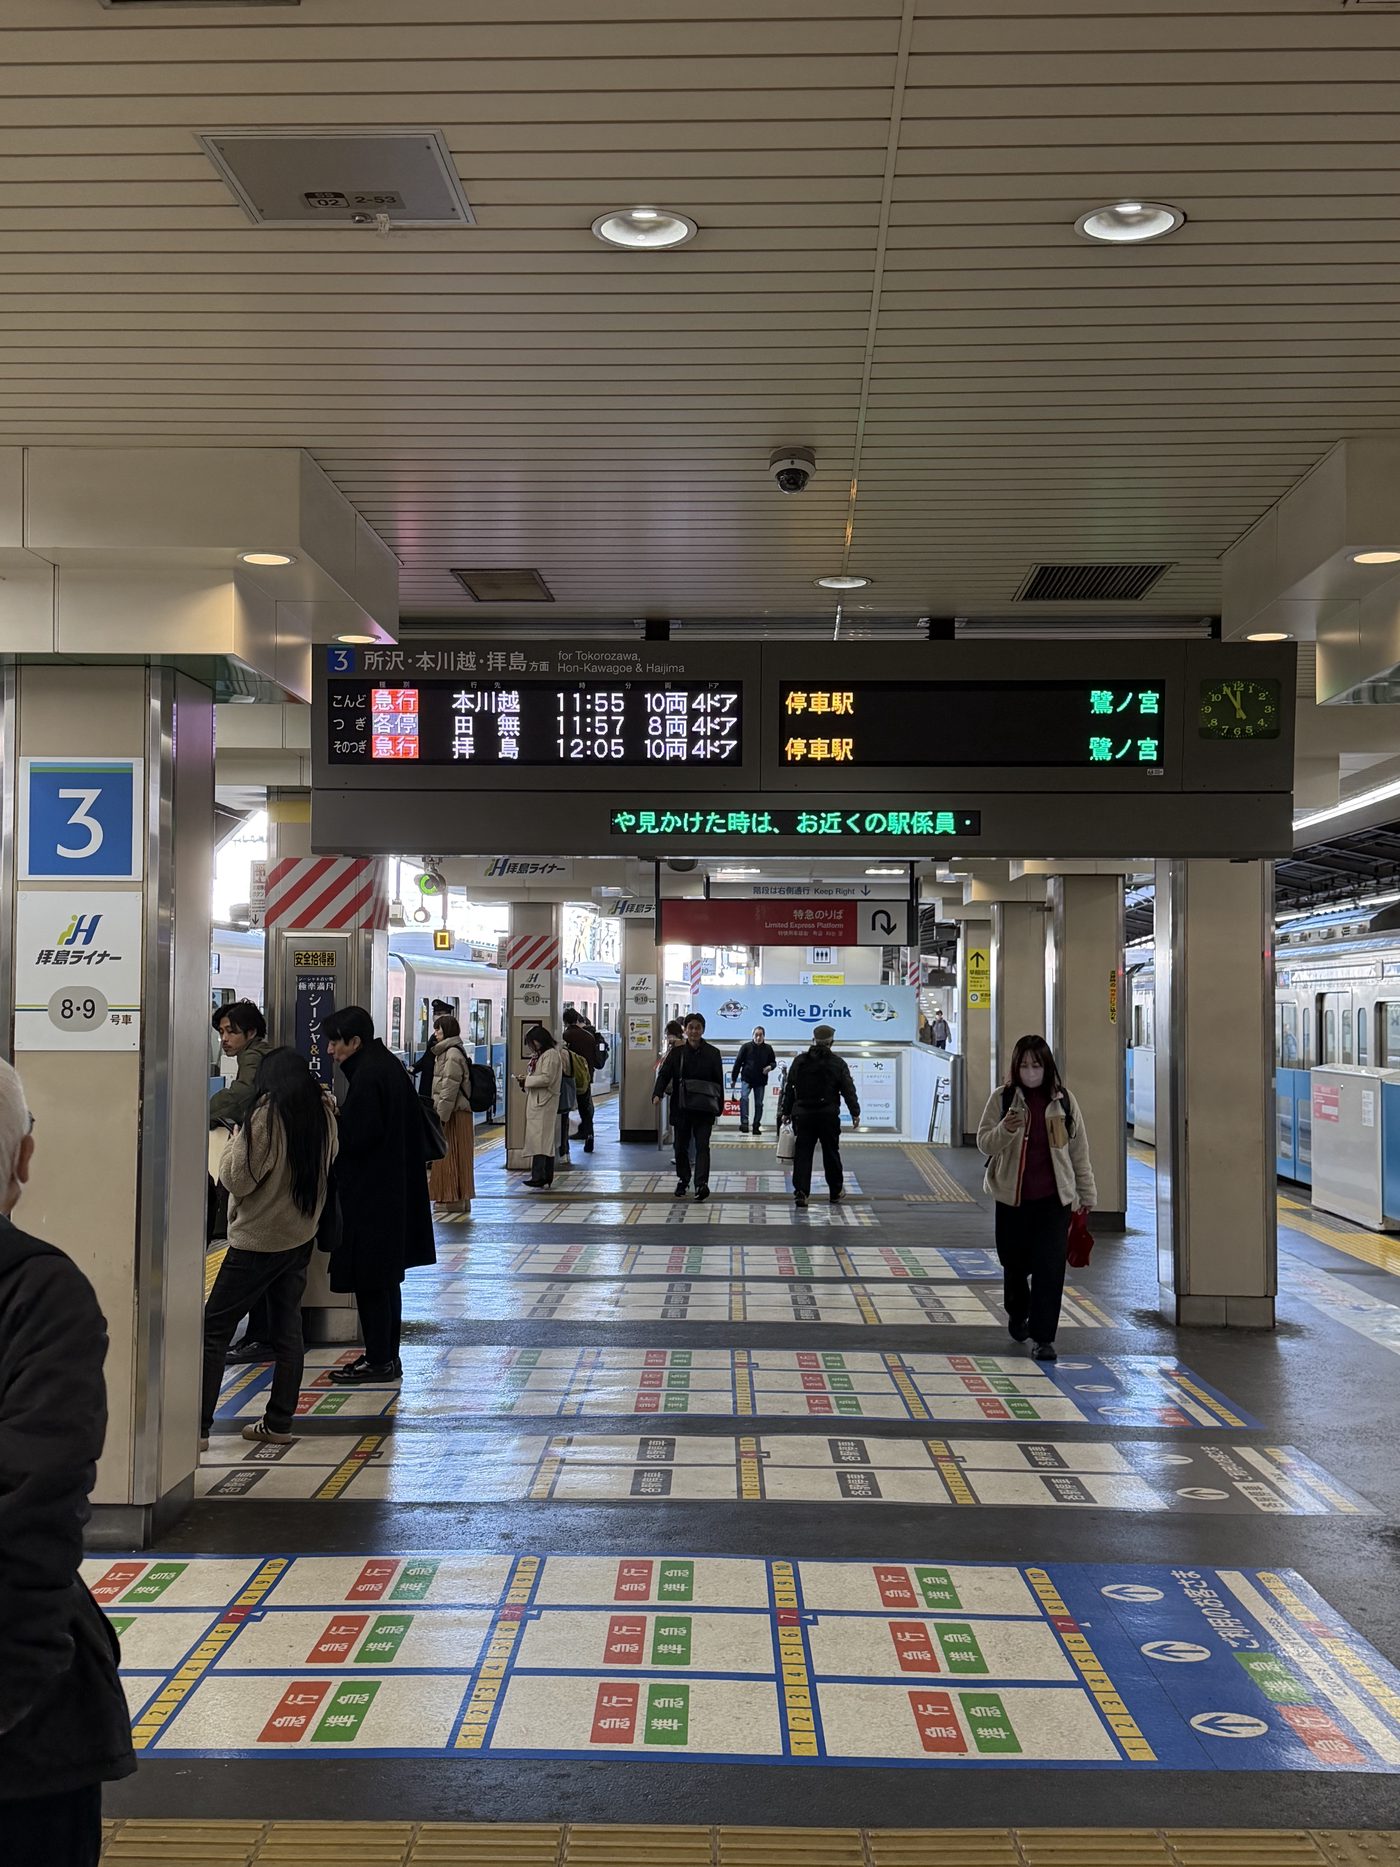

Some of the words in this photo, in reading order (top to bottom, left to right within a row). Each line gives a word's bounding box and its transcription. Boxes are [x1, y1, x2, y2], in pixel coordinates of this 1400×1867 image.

[354, 196, 397, 204] 2-53
[333, 650, 349, 672] 3
[558, 651, 573, 662] for
[577, 651, 641, 663] Tokorozawa,
[557, 663, 633, 674] Hon-Kawagoe
[635, 663, 643, 673] &
[646, 663, 685, 674] Haijima
[1211, 693, 1222, 701] 10
[1233, 683, 1244, 691] 12
[1258, 692, 1266, 701] 2
[333, 694, 367, 708] こんど
[374, 690, 417, 712] 急行
[452, 690, 521, 713] 本川越
[557, 693, 625, 712] 11:55
[644, 692, 689, 714] 10両
[692, 693, 738, 713] 4ドア
[785, 691, 854, 715] 停車駅
[1090, 691, 1159, 715] 鷺ノ宮
[1204, 705, 1212, 713] 9
[1264, 705, 1272, 713] 3
[374, 713, 417, 735] 各停
[557, 716, 625, 735] 11:57
[692, 716, 738, 736] 4ドア
[1210, 718, 1218, 726] 8
[1222, 725, 1229, 734] 7
[1233, 727, 1241, 735] 6
[1245, 725, 1253, 734] 5
[1257, 718, 1265, 726] 4
[333, 740, 367, 754] そのつぎ
[374, 737, 417, 758] 急行
[557, 739, 625, 758] 12:05
[644, 738, 688, 760] 10両
[692, 739, 738, 759] 4ドア
[785, 737, 854, 761] 停車駅
[1089, 737, 1158, 761] 鷺ノ宮
[56, 788, 104, 859] 3
[506, 862, 566, 875] 拝島ライナー
[814, 887, 834, 897] Keep
[835, 886, 856, 897] Right
[624, 903, 656, 914] 拝島ラ
[793, 908, 844, 920] 特急のりば
[765, 921, 789, 929] Limited
[789, 922, 815, 930] Express
[816, 921, 844, 929] Platform
[35, 949, 122, 966] 拝島ライナー
[110, 1013, 133, 1026] 号車
[762, 1001, 806, 1018] Smile
[810, 1001, 852, 1018] Drink
[134, 1572, 177, 1594] 準急
[356, 1567, 392, 1592] 急行
[619, 1568, 649, 1592] 急行
[663, 1569, 690, 1592] 準急
[880, 1574, 911, 1599] 急行
[922, 1576, 953, 1600] 準急
[318, 1625, 359, 1652] 急行
[365, 1624, 405, 1652] 準急
[609, 1625, 642, 1653] 急行
[656, 1626, 687, 1654] 準急
[896, 1631, 932, 1661] 急行
[943, 1633, 979, 1662] 準急
[272, 1694, 320, 1728] 急行
[324, 1693, 370, 1727] 準急
[597, 1695, 633, 1730] 急行
[650, 1697, 684, 1731] 準急
[917, 1703, 957, 1739] 急行
[969, 1705, 1010, 1740] 準急
